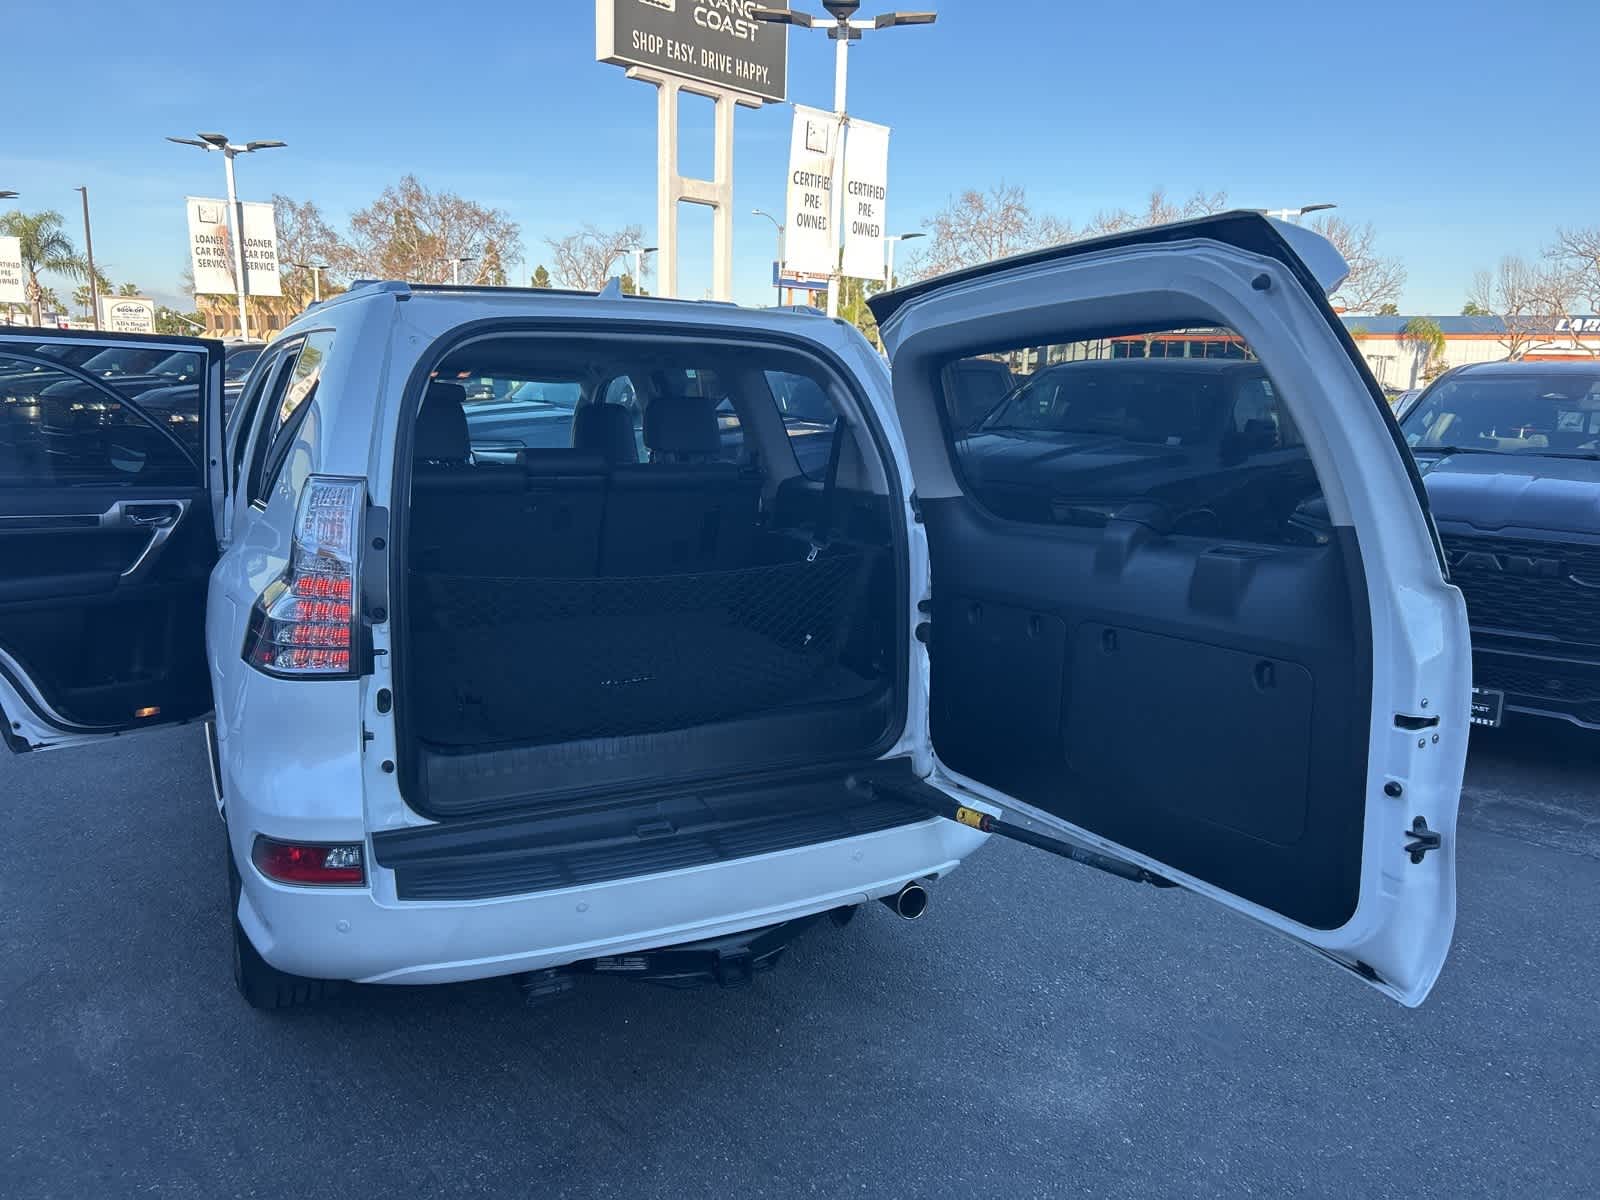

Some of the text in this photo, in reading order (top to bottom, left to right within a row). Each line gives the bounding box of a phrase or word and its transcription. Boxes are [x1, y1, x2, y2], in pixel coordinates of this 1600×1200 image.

[694, 6, 759, 42] COAST
[632, 30, 771, 85] SHOP EASY. DRIVE HAPPY.
[793, 170, 831, 191] CERTIFIED
[848, 180, 885, 201] CERTIFIED
[804, 192, 822, 209] PRE-
[858, 201, 875, 217] PRE-
[796, 212, 827, 231] OWNED
[852, 220, 880, 238] OWNED
[195, 234, 224, 246] LOANER
[244, 238, 273, 249] LOANER
[195, 246, 226, 257] CAR FOR
[244, 249, 275, 260] CAR FOR
[198, 258, 227, 269] SERVICE
[245, 261, 275, 272] SERVICE
